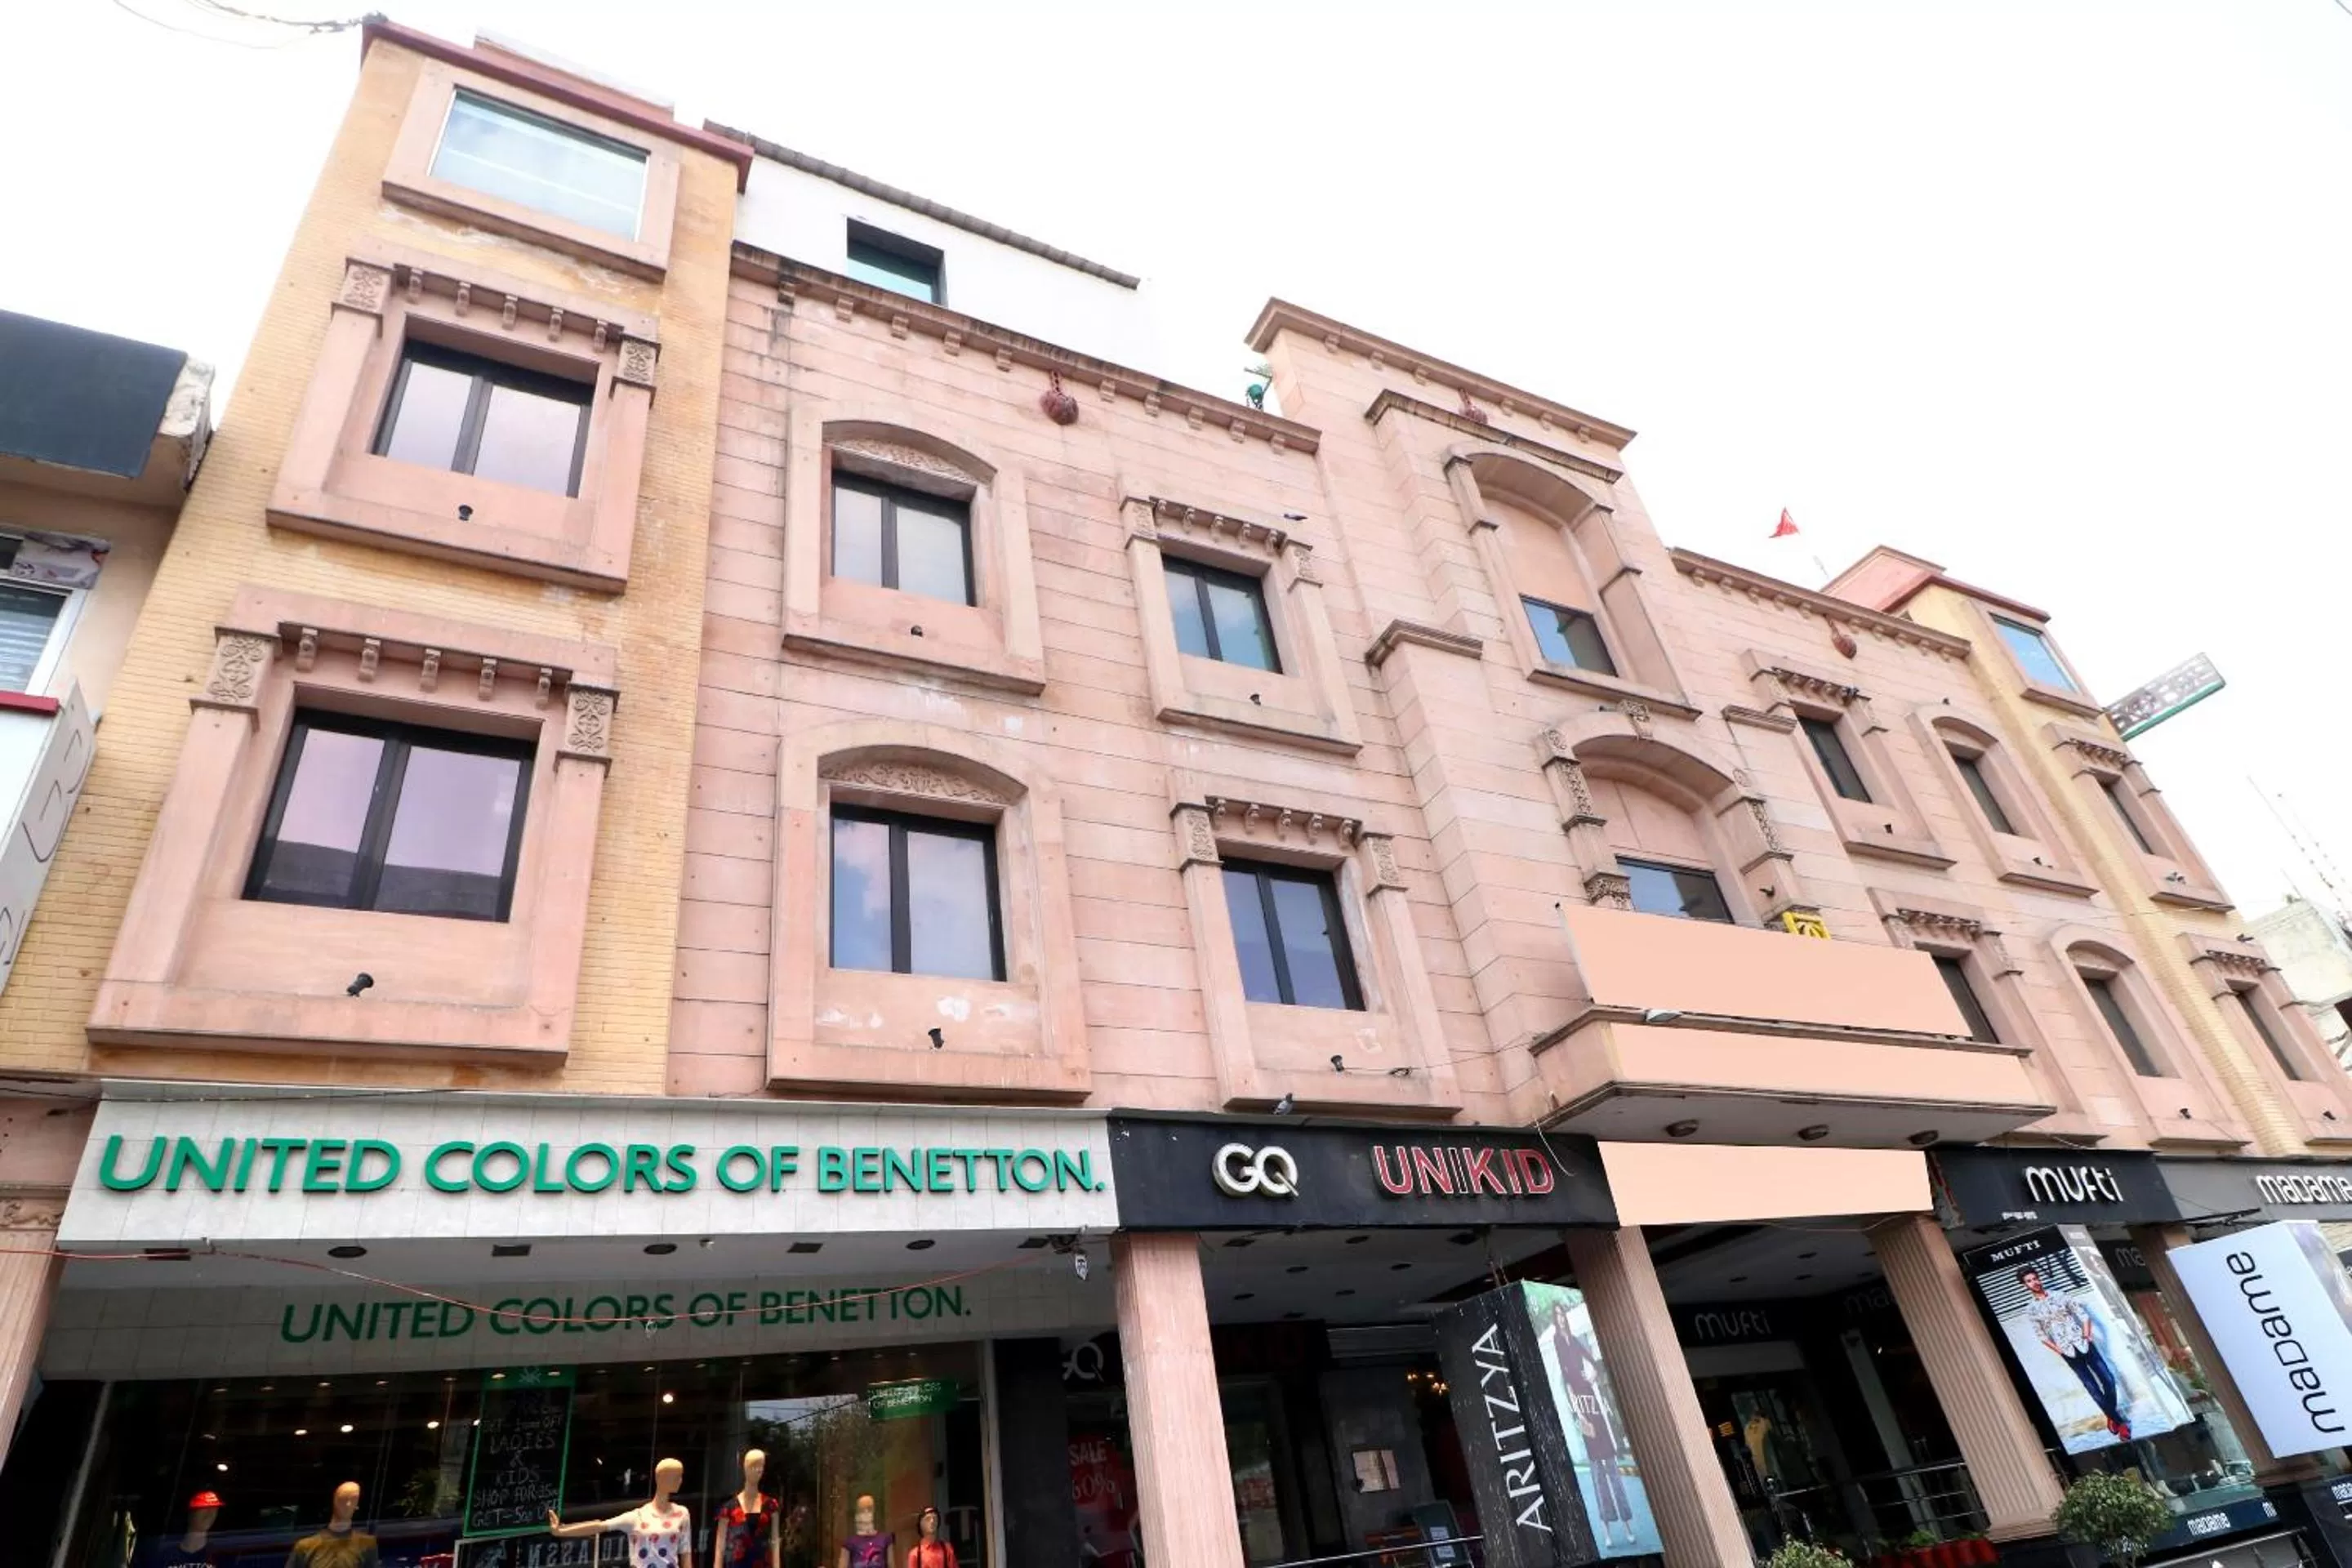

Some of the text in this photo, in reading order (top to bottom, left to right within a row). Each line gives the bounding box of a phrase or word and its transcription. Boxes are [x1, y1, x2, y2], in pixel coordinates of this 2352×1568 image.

[99, 1134, 1106, 1194] UNITED COLORS OF BENETTON.
[1211, 1143, 1300, 1198] GQ
[1371, 1145, 1556, 1199] UNIKID
[2023, 1165, 2123, 1204] mufti
[1990, 1239, 2042, 1263] MUFTI
[280, 1299, 475, 1343] UNITED
[490, 1294, 675, 1334] COLORS
[688, 1290, 747, 1328] OF
[1067, 1440, 1108, 1468] SALE
[1471, 1322, 1552, 1535] ARITZYA
